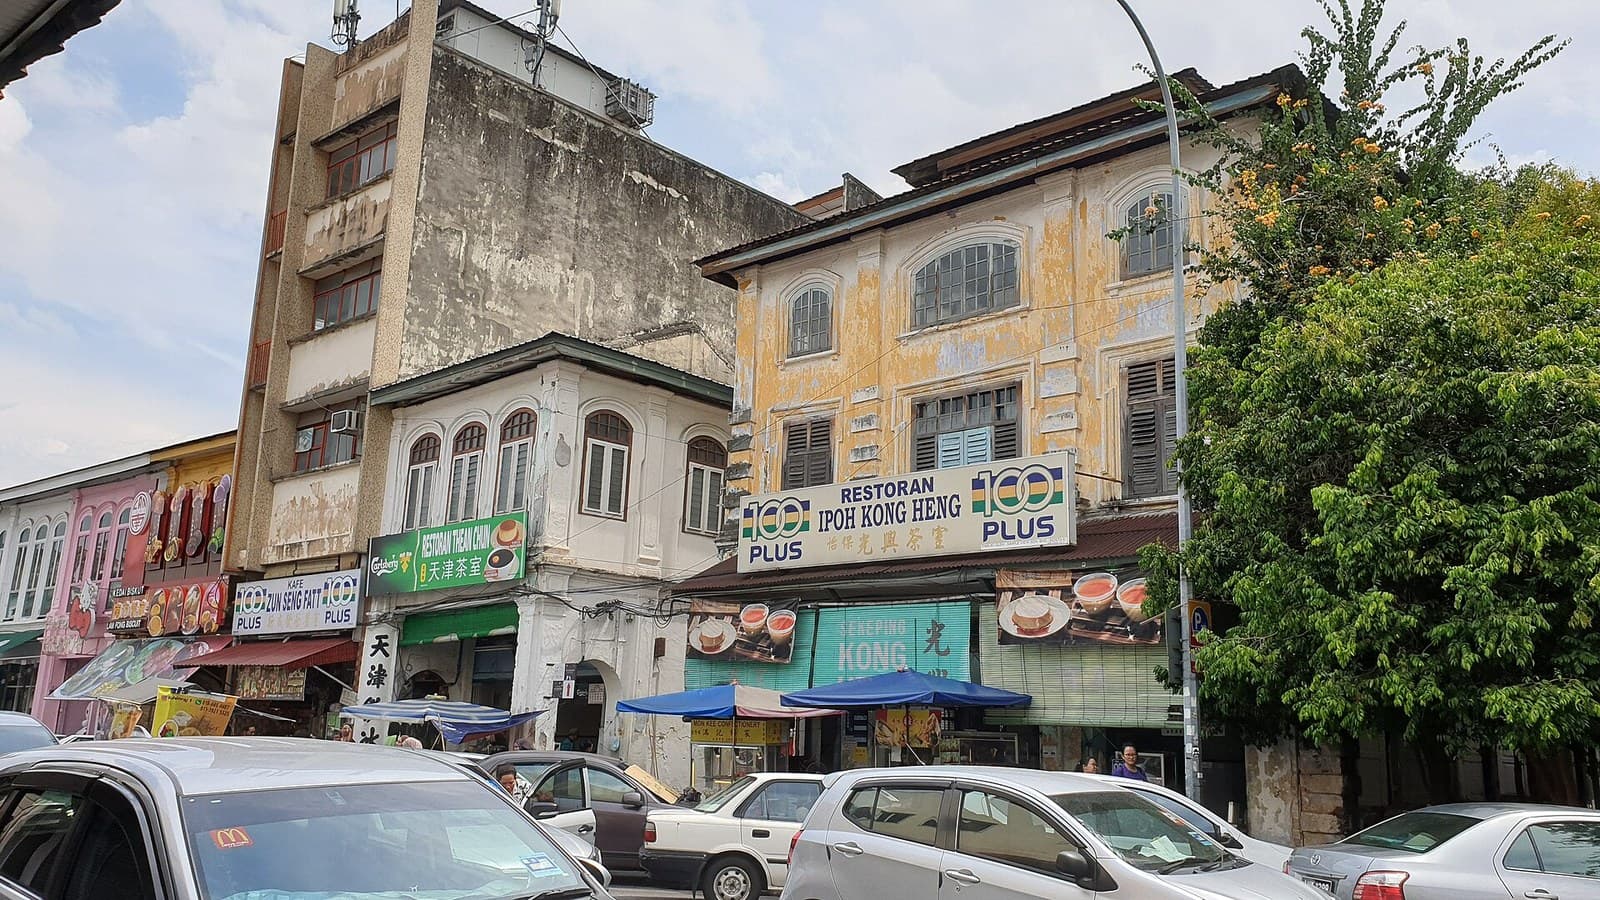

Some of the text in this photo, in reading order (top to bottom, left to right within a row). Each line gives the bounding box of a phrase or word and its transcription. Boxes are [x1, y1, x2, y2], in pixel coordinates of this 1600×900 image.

[841, 477, 934, 504] RESTORAN
[978, 464, 1055, 517] 100
[748, 497, 804, 542] 100
[818, 494, 961, 533] IPOH KONG HENG
[422, 524, 490, 558] RESTORAN THEAN CHUN
[983, 515, 1055, 542] PLUS
[371, 554, 399, 576] Carlsberg
[750, 541, 802, 564] PLUS
[428, 556, 482, 582] 天津茶室
[287, 579, 304, 590] KAFE
[326, 575, 353, 608] 100
[239, 585, 264, 615] 100
[266, 588, 322, 613] ZUN SENG FATT
[237, 616, 262, 629] PLUS
[324, 609, 351, 624] PLUS
[838, 640, 907, 671] KONG
